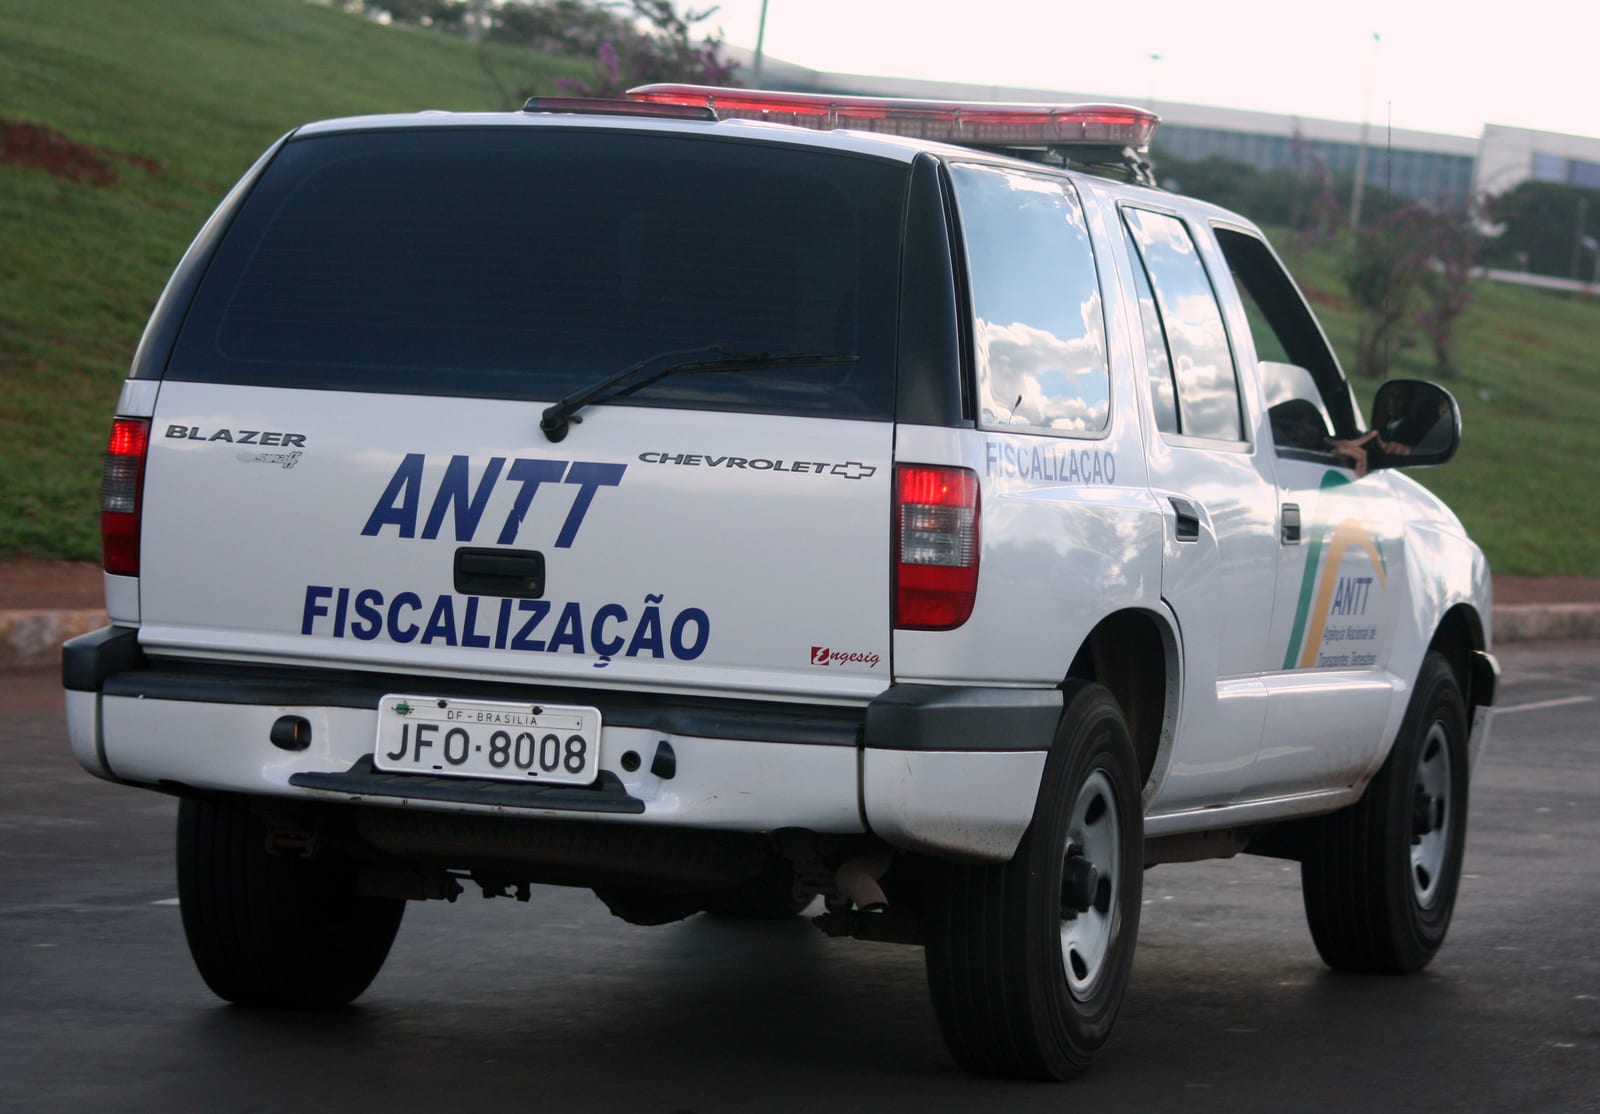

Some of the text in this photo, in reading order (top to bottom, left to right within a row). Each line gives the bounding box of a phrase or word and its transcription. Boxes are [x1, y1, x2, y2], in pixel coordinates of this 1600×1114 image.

[165, 424, 306, 448] BLAZER
[638, 452, 831, 474] CHEVROLET
[361, 453, 628, 548] ANTT
[1331, 577, 1373, 615] ANTT
[301, 585, 710, 668] FISCALIZAÇÃO
[811, 646, 881, 668] Engesig
